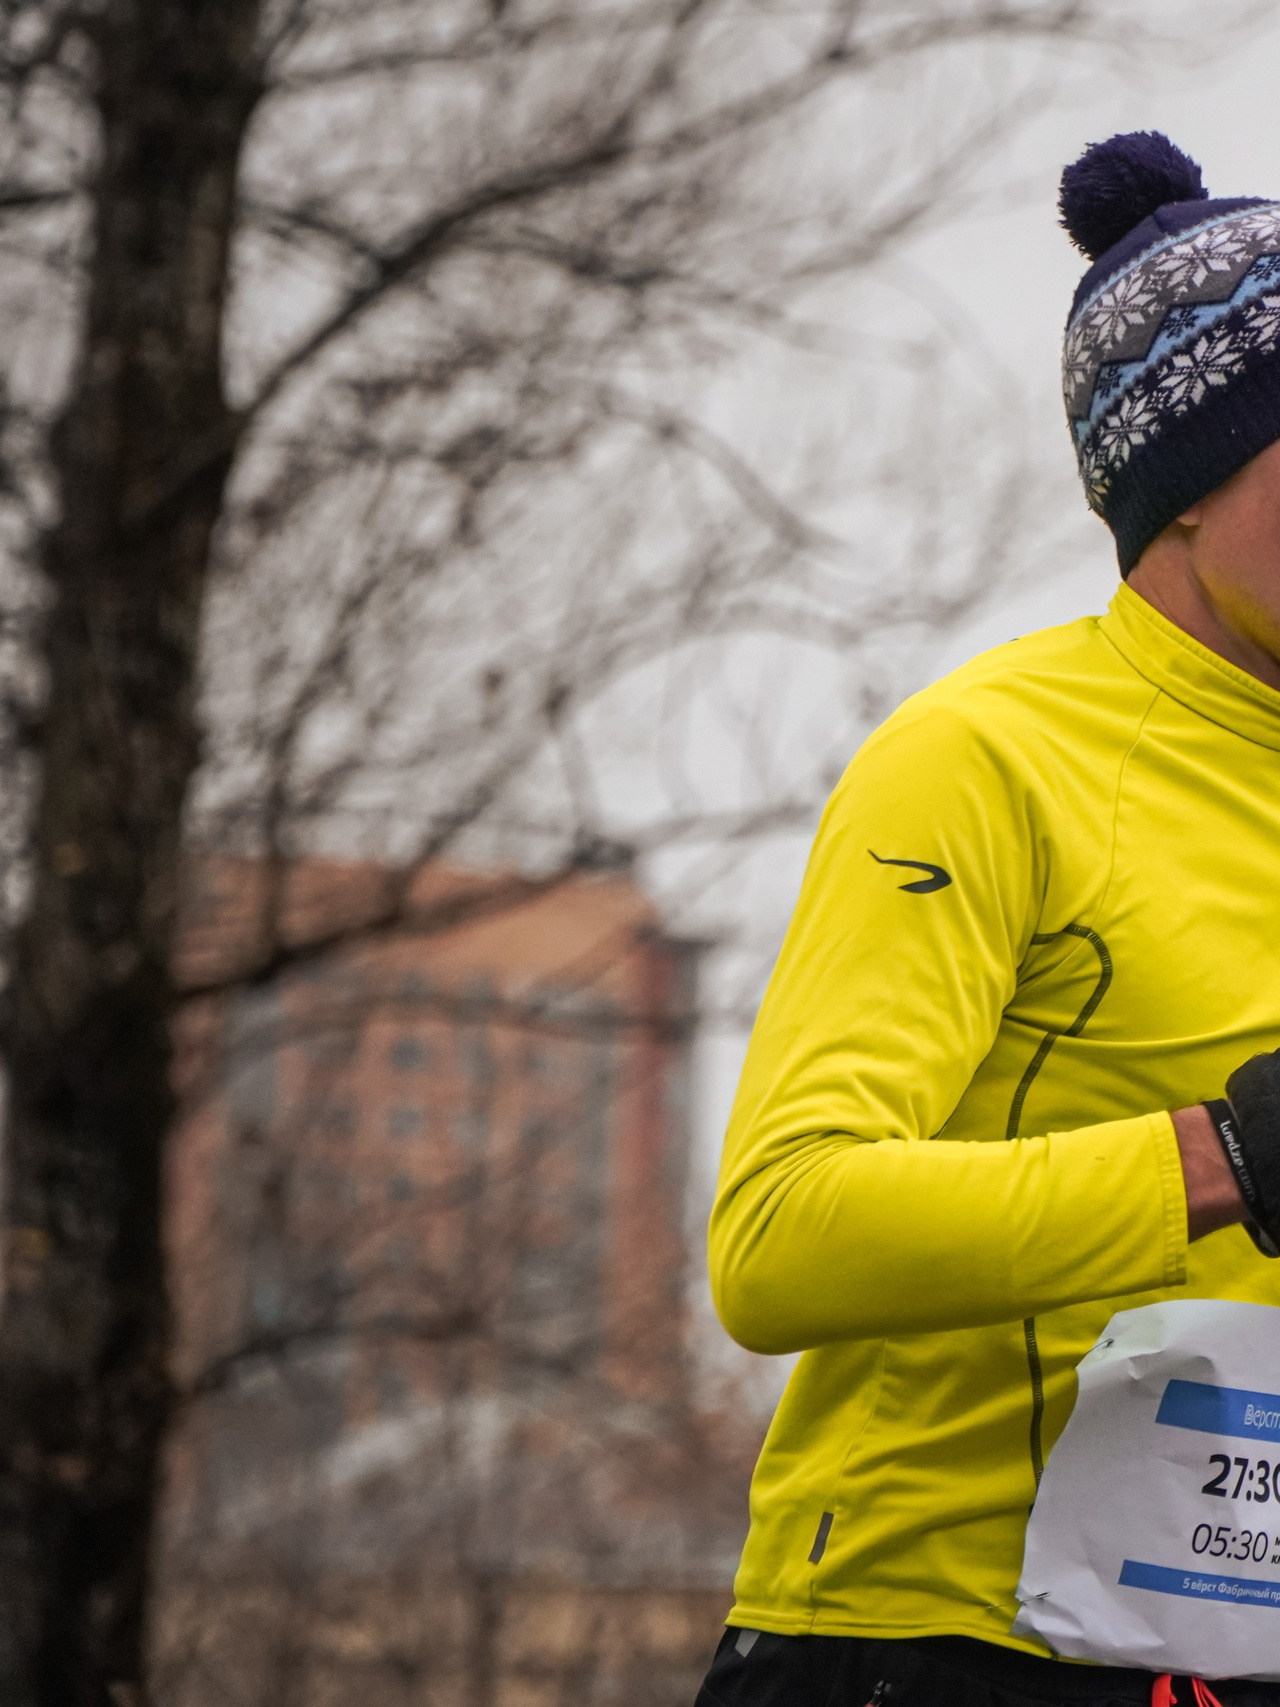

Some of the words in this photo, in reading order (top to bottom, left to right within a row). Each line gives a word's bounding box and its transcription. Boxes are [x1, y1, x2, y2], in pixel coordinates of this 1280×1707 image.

[1191, 1524, 1268, 1562] 05:30
[1182, 1578, 1190, 1589] 5
[1191, 1580, 1216, 1594] вёрст
[1218, 1582, 1269, 1599] Фабричный
